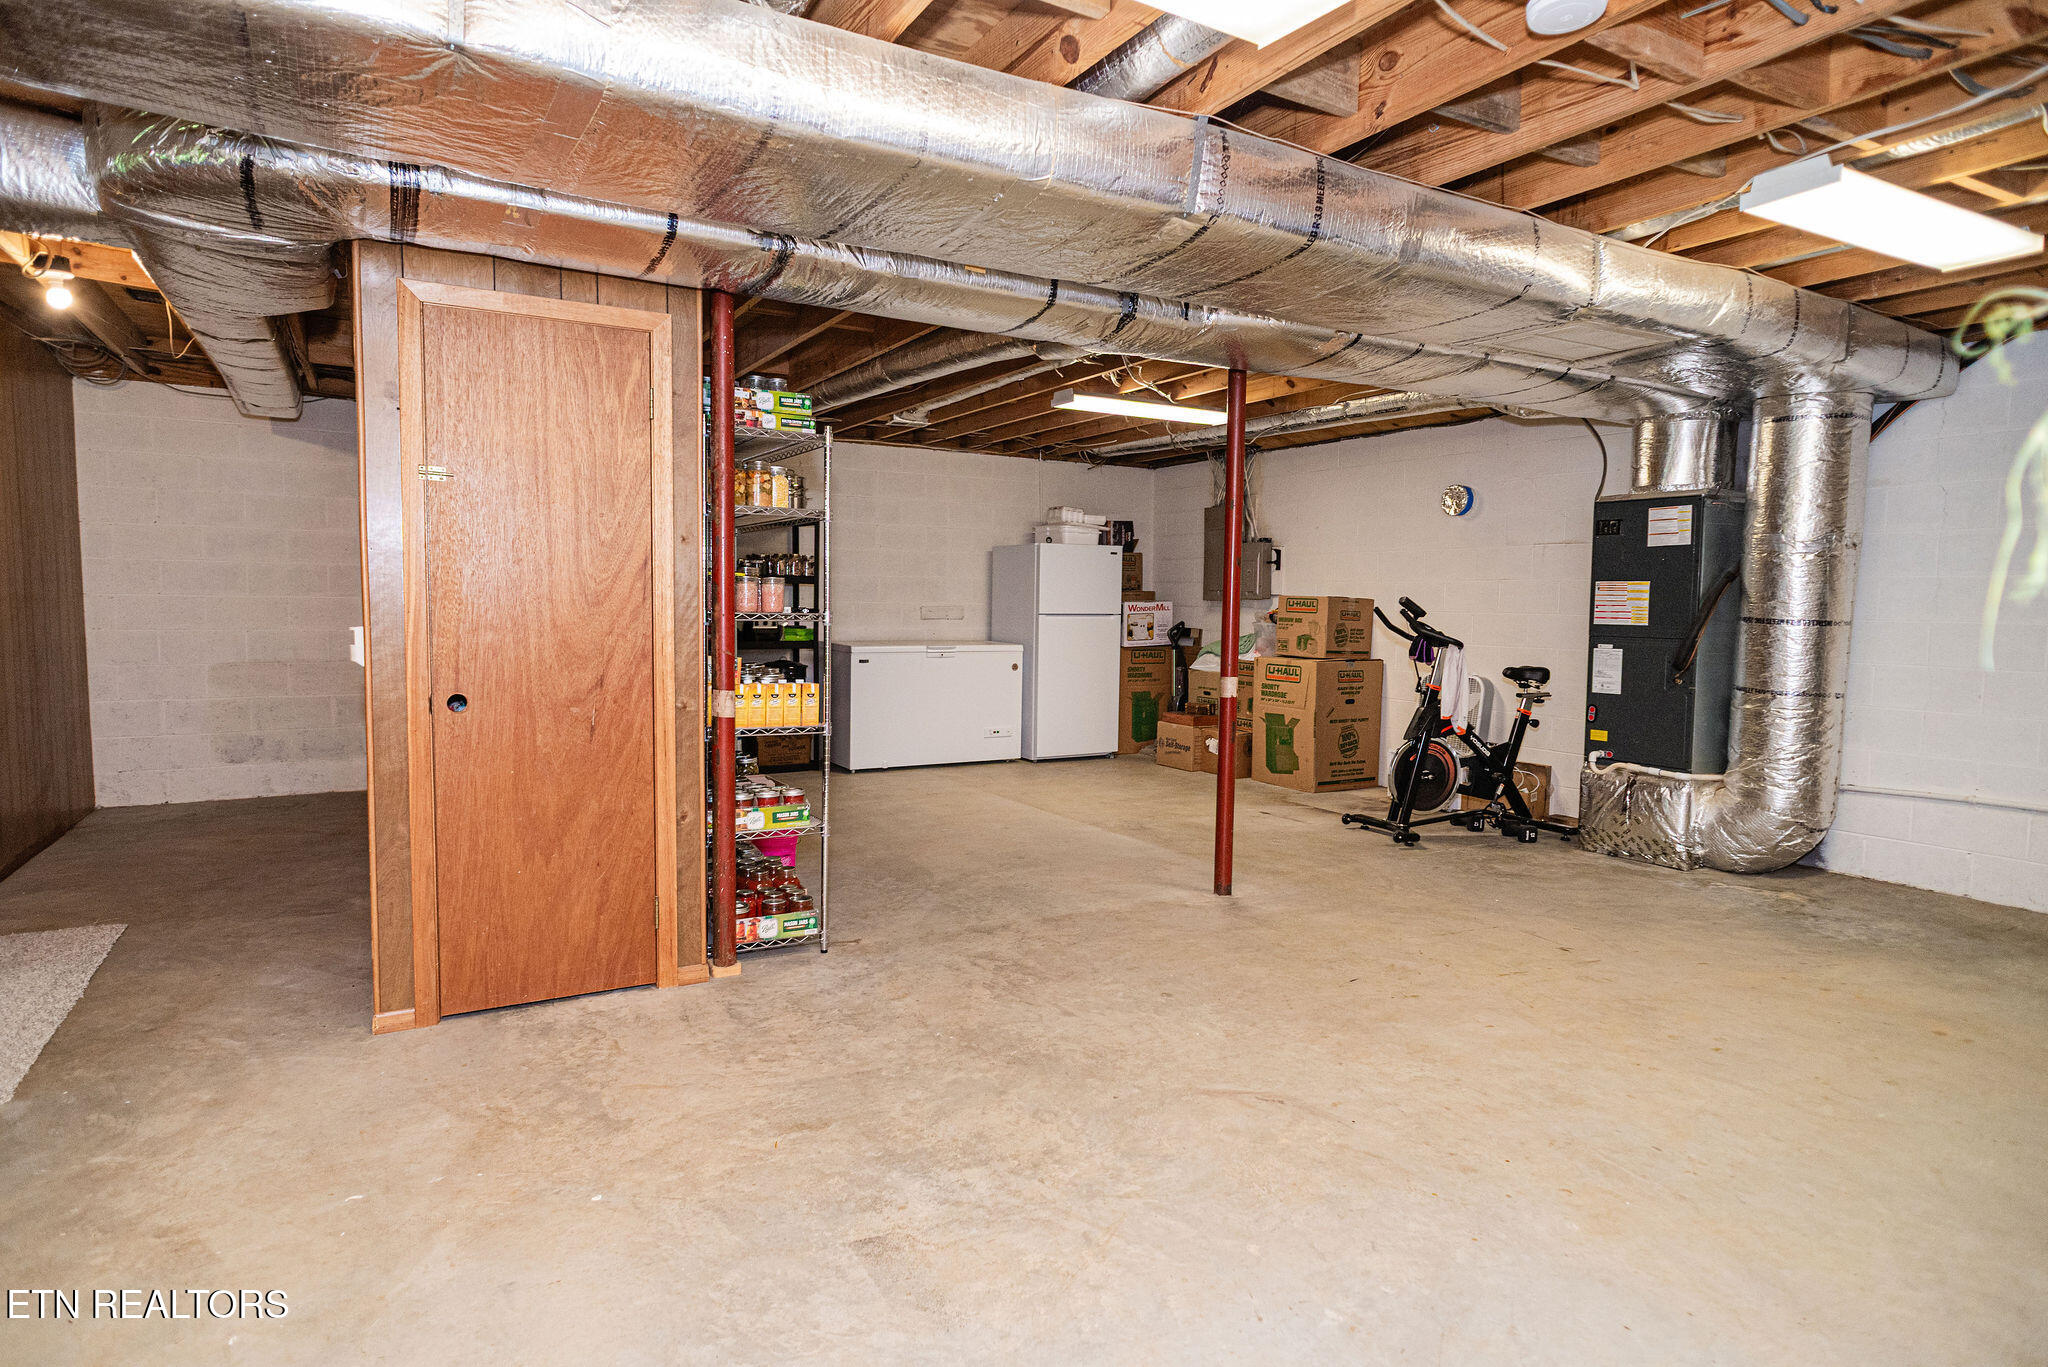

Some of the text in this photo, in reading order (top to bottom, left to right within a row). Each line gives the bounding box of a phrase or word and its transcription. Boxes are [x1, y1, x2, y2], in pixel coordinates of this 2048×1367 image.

[1315, 175, 1325, 205] MEETS
[1288, 600, 1316, 608] U-HAUL
[1133, 651, 1164, 659] U-HAUL
[1267, 666, 1299, 676] U-HAUL
[1260, 682, 1280, 690] SHORTY
[1261, 690, 1288, 698] WARDROBE
